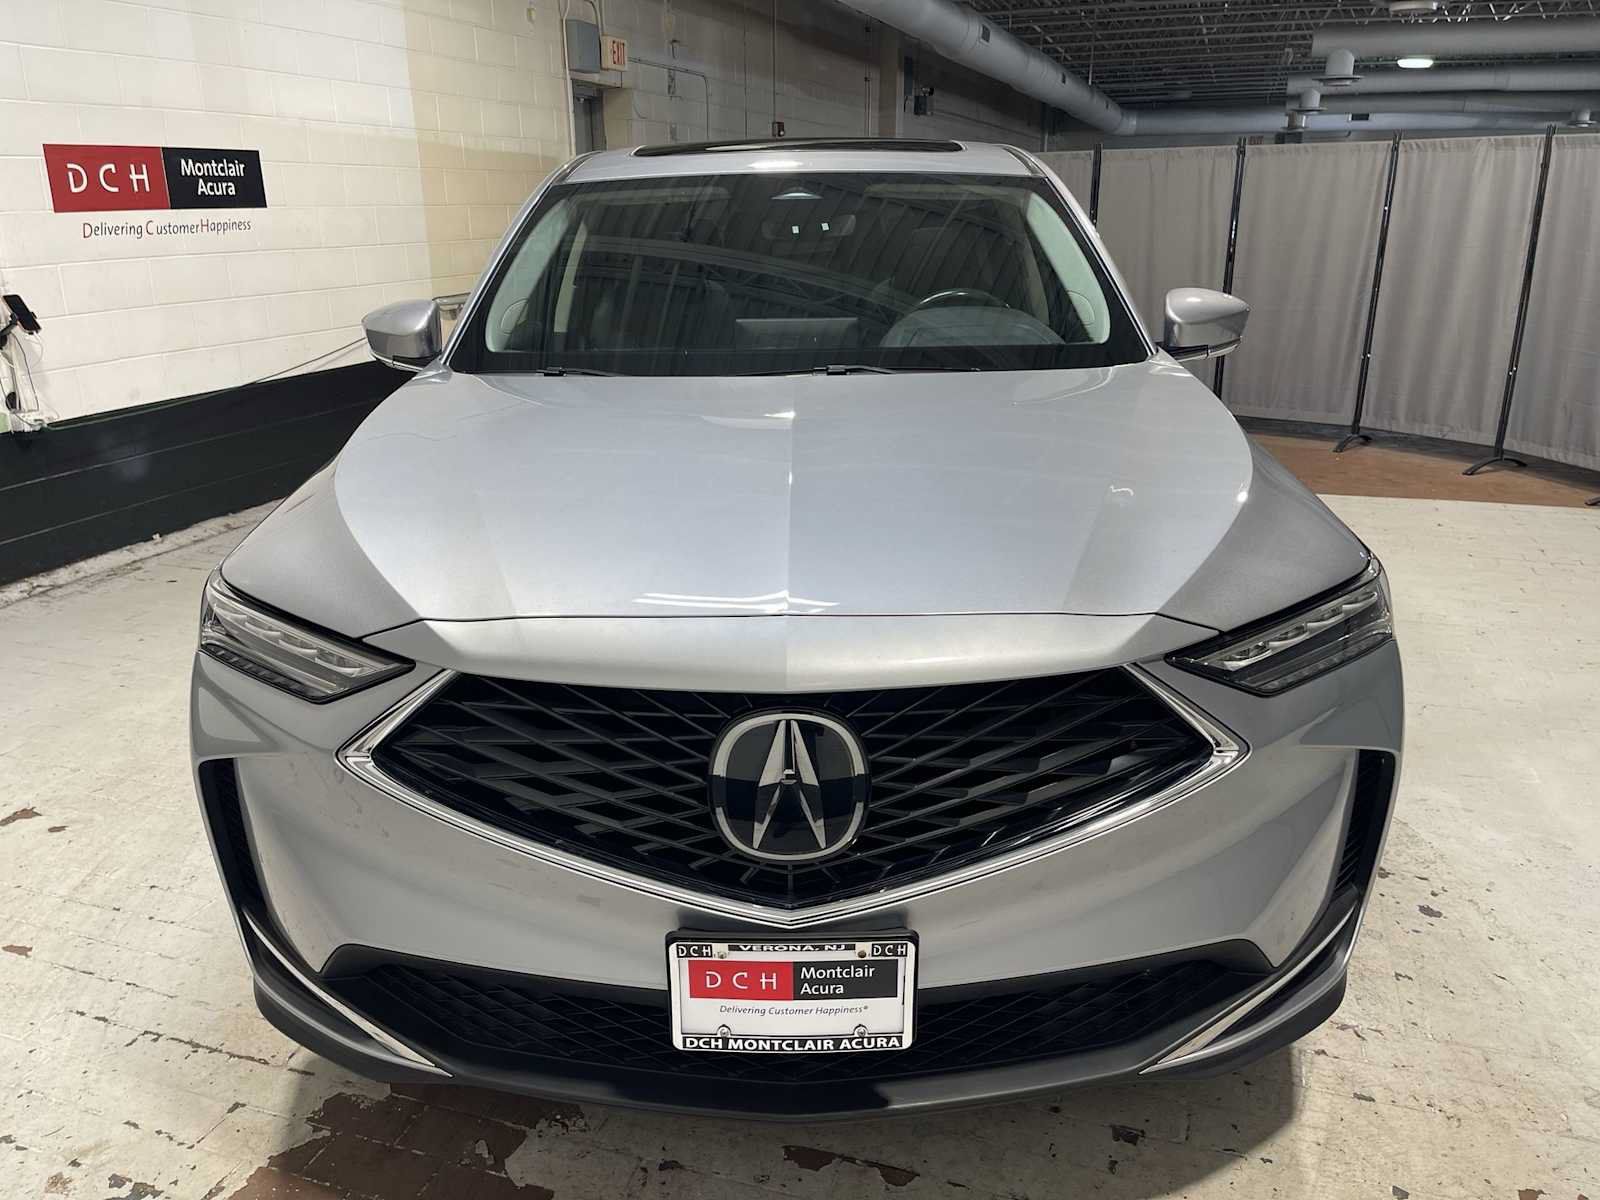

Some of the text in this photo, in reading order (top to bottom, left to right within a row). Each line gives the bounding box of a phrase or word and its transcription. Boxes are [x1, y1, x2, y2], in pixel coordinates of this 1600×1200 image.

[180, 158, 246, 178] Montclair
[197, 178, 236, 196] Acura
[82, 218, 252, 240] Delivering Customer Happiness
[678, 945, 712, 957] DCH
[872, 943, 907, 956] DCH
[800, 965, 875, 980] Montclair
[800, 982, 844, 995] Acura
[719, 1004, 767, 1016] Delivering
[768, 1006, 813, 1015] Customer
[685, 1036, 901, 1051] DCH MONTCLAIR ACURA
